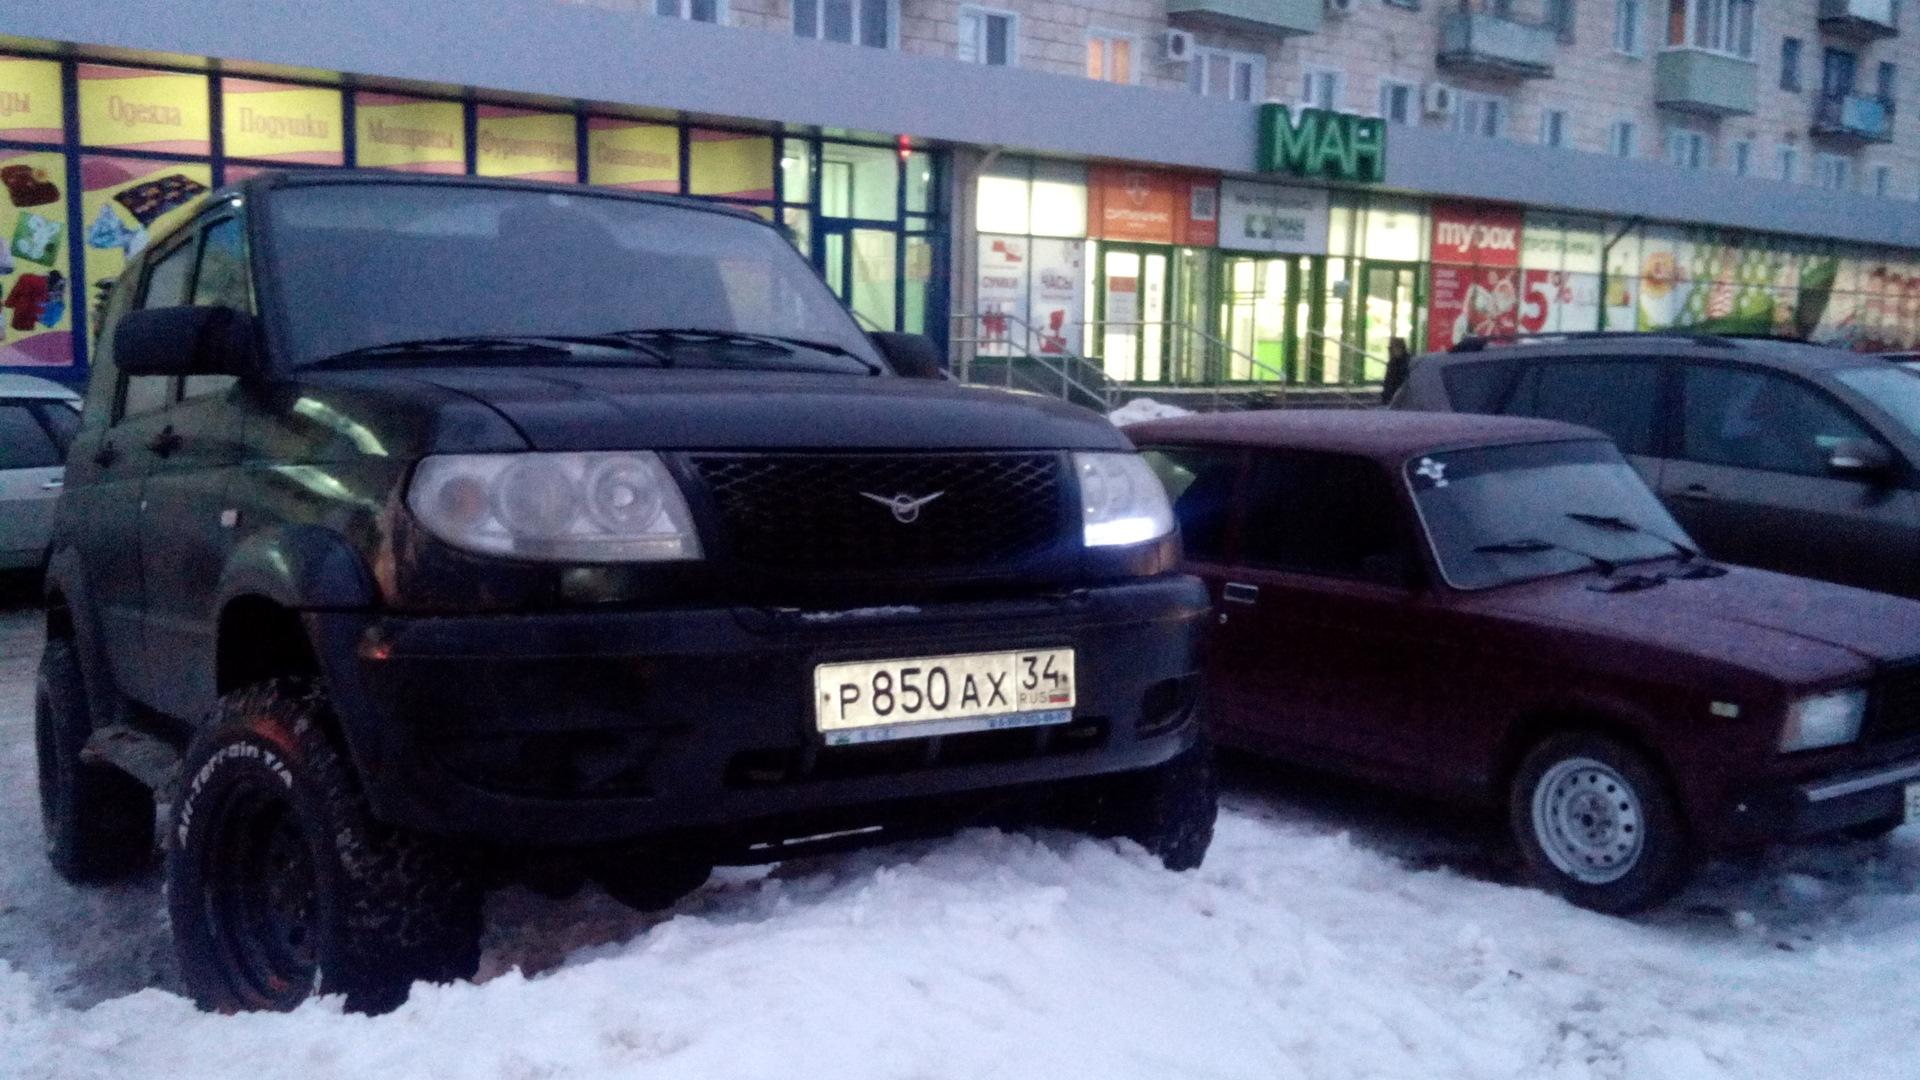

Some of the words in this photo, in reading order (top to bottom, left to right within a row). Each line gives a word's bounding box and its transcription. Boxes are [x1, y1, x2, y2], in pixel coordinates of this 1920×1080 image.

[240, 106, 329, 140] Подушки
[1264, 105, 1386, 182] МАН
[1022, 654, 1060, 690] 34
